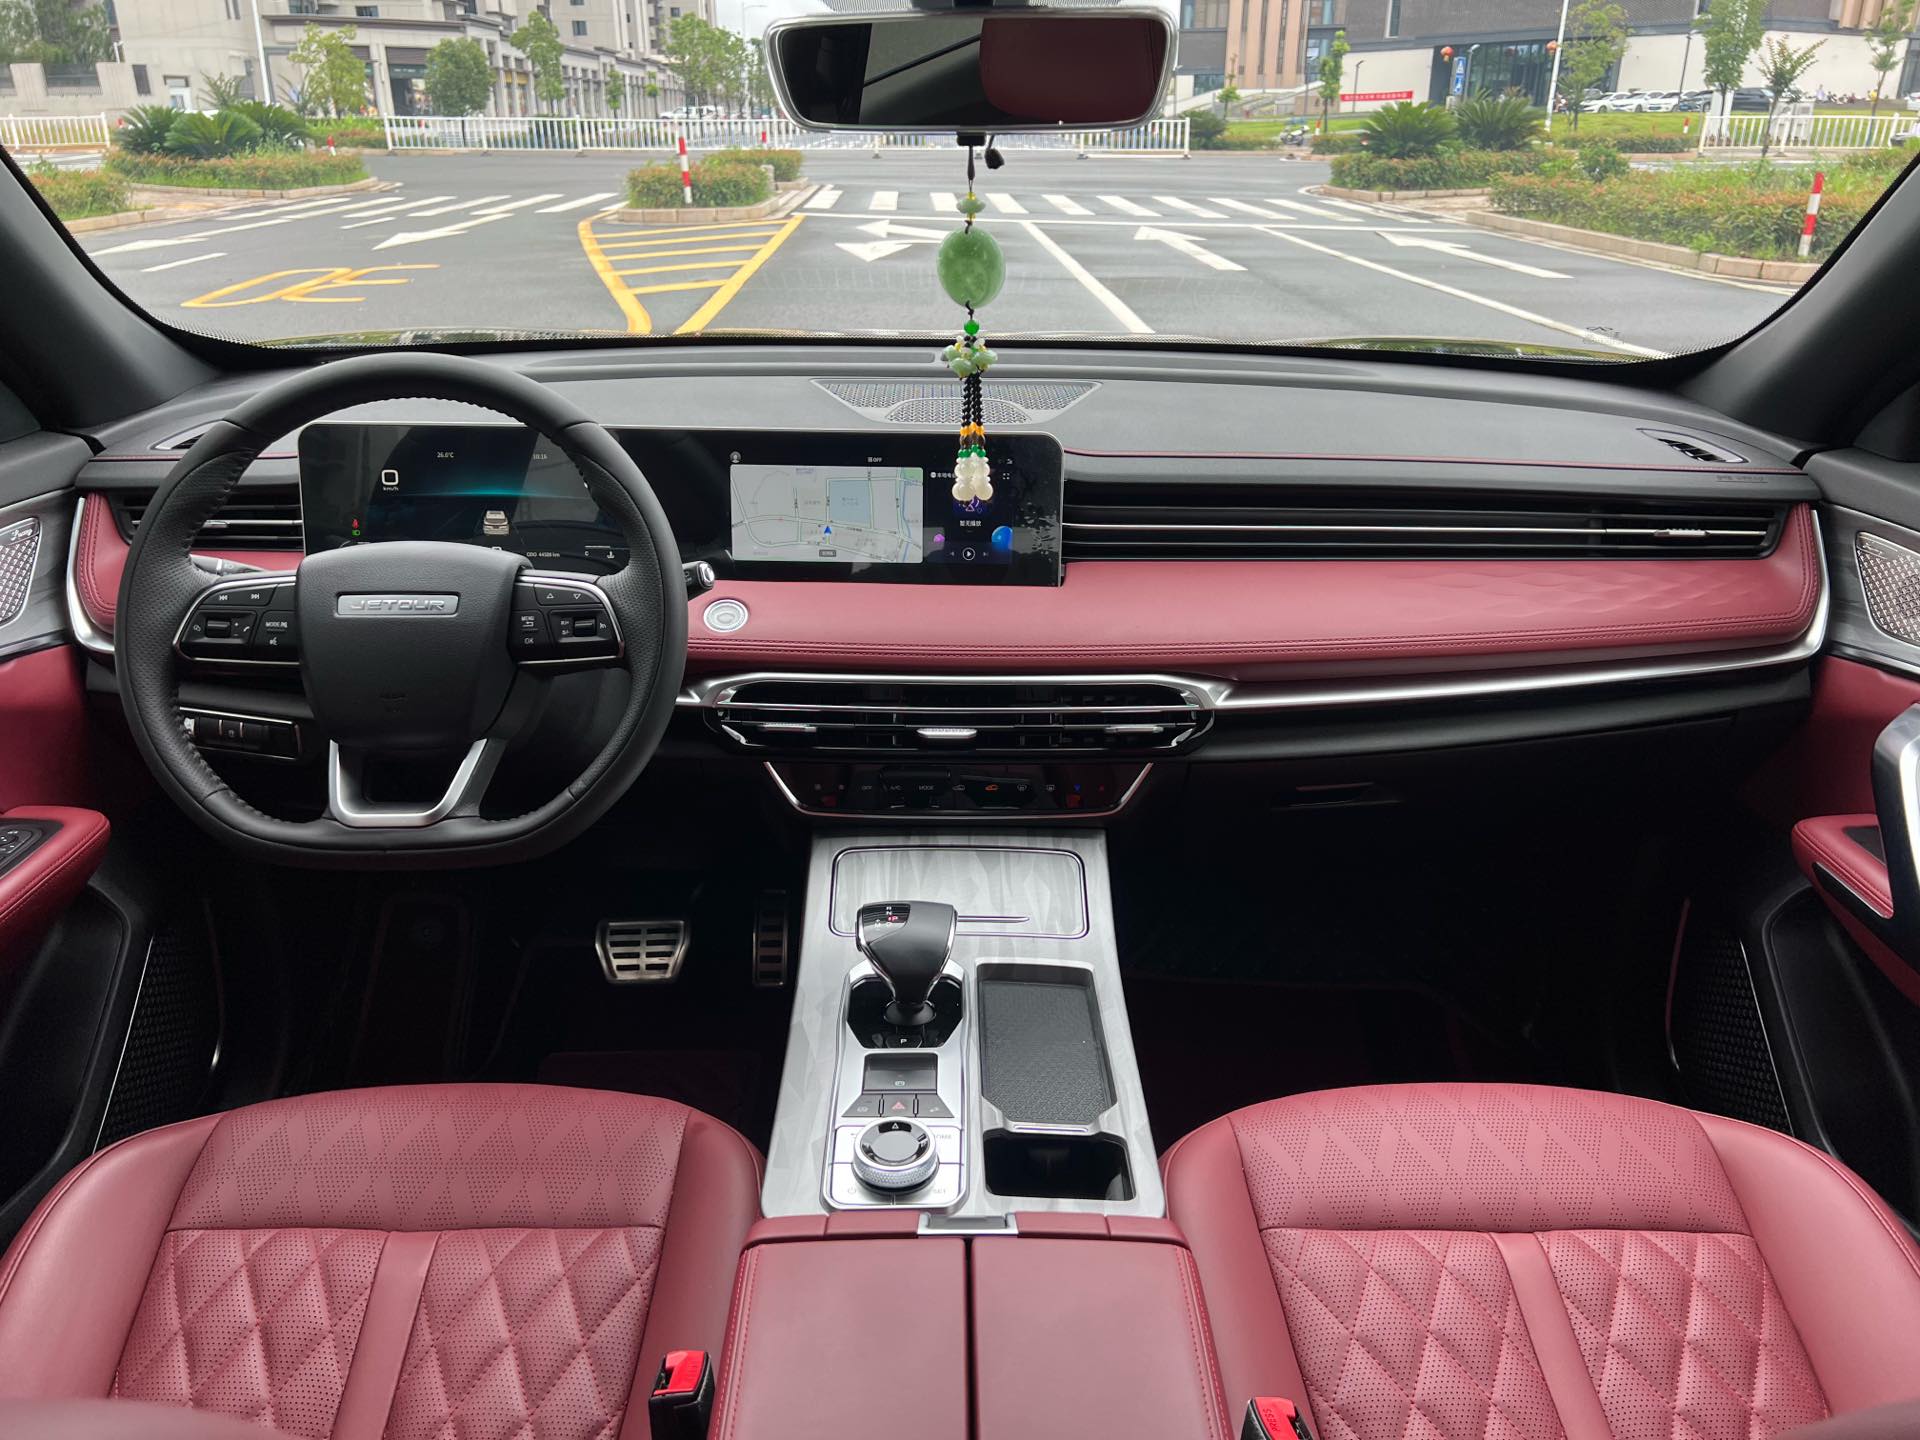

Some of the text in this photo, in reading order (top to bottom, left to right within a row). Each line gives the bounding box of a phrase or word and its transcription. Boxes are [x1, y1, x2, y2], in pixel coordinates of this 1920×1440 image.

[350, 599, 446, 611] JETOUR
[524, 637, 534, 645] OK
[1263, 1407, 1281, 1432] PRESS
